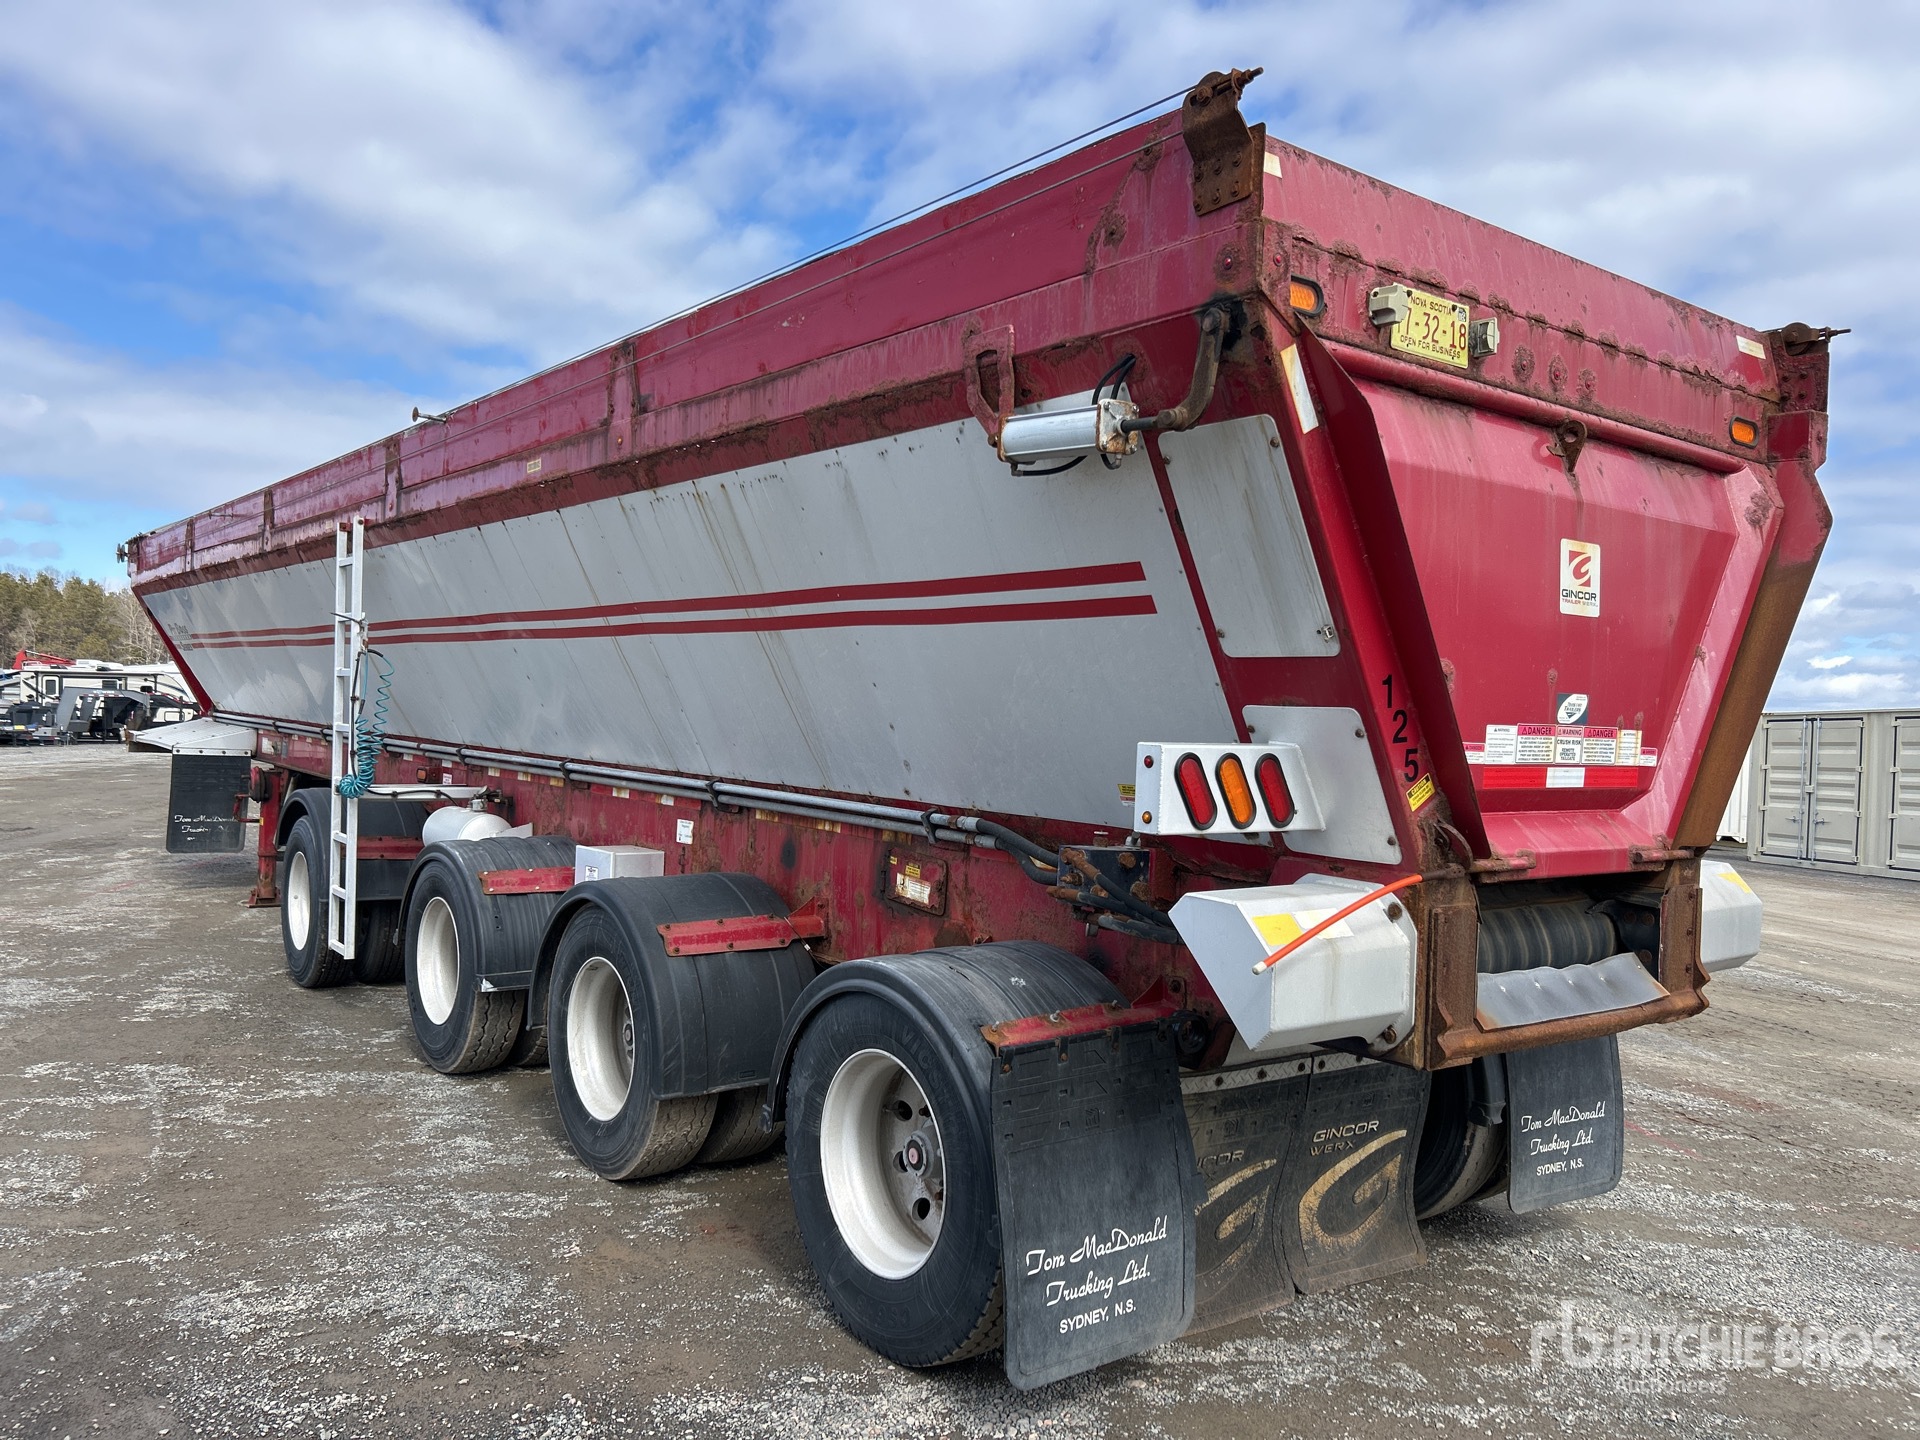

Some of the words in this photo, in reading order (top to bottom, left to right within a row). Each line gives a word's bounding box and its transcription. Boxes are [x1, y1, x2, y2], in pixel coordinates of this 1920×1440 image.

[1411, 296, 1427, 308] NOVA
[1430, 301, 1452, 316] SCOTIA
[1400, 334, 1416, 347] OPEN
[1417, 339, 1431, 351] FOR
[1431, 343, 1461, 359] BUSINESS
[1561, 588, 1597, 602] GINCOR
[1527, 726, 1552, 736] DANGER
[1562, 729, 1582, 737] WARNING
[1593, 729, 1614, 738] DANGER
[1521, 1115, 1542, 1133] Tom
[1544, 1100, 1606, 1127] MacDonald
[1312, 1120, 1380, 1143] GINCOR
[1530, 1133, 1570, 1156] Trucking
[1571, 1127, 1594, 1147] Ltd.
[1310, 1139, 1356, 1157] WERX
[1536, 1160, 1567, 1176] SYDNEY,
[1570, 1158, 1585, 1170] N.S.
[1026, 1249, 1066, 1276] Tom
[1069, 1215, 1168, 1263] MacDonald
[1046, 1270, 1114, 1307] Trucking
[1117, 1254, 1151, 1287] Ltd.
[1059, 1306, 1110, 1334] SYDNEY,
[1114, 1298, 1137, 1318] N.S.
